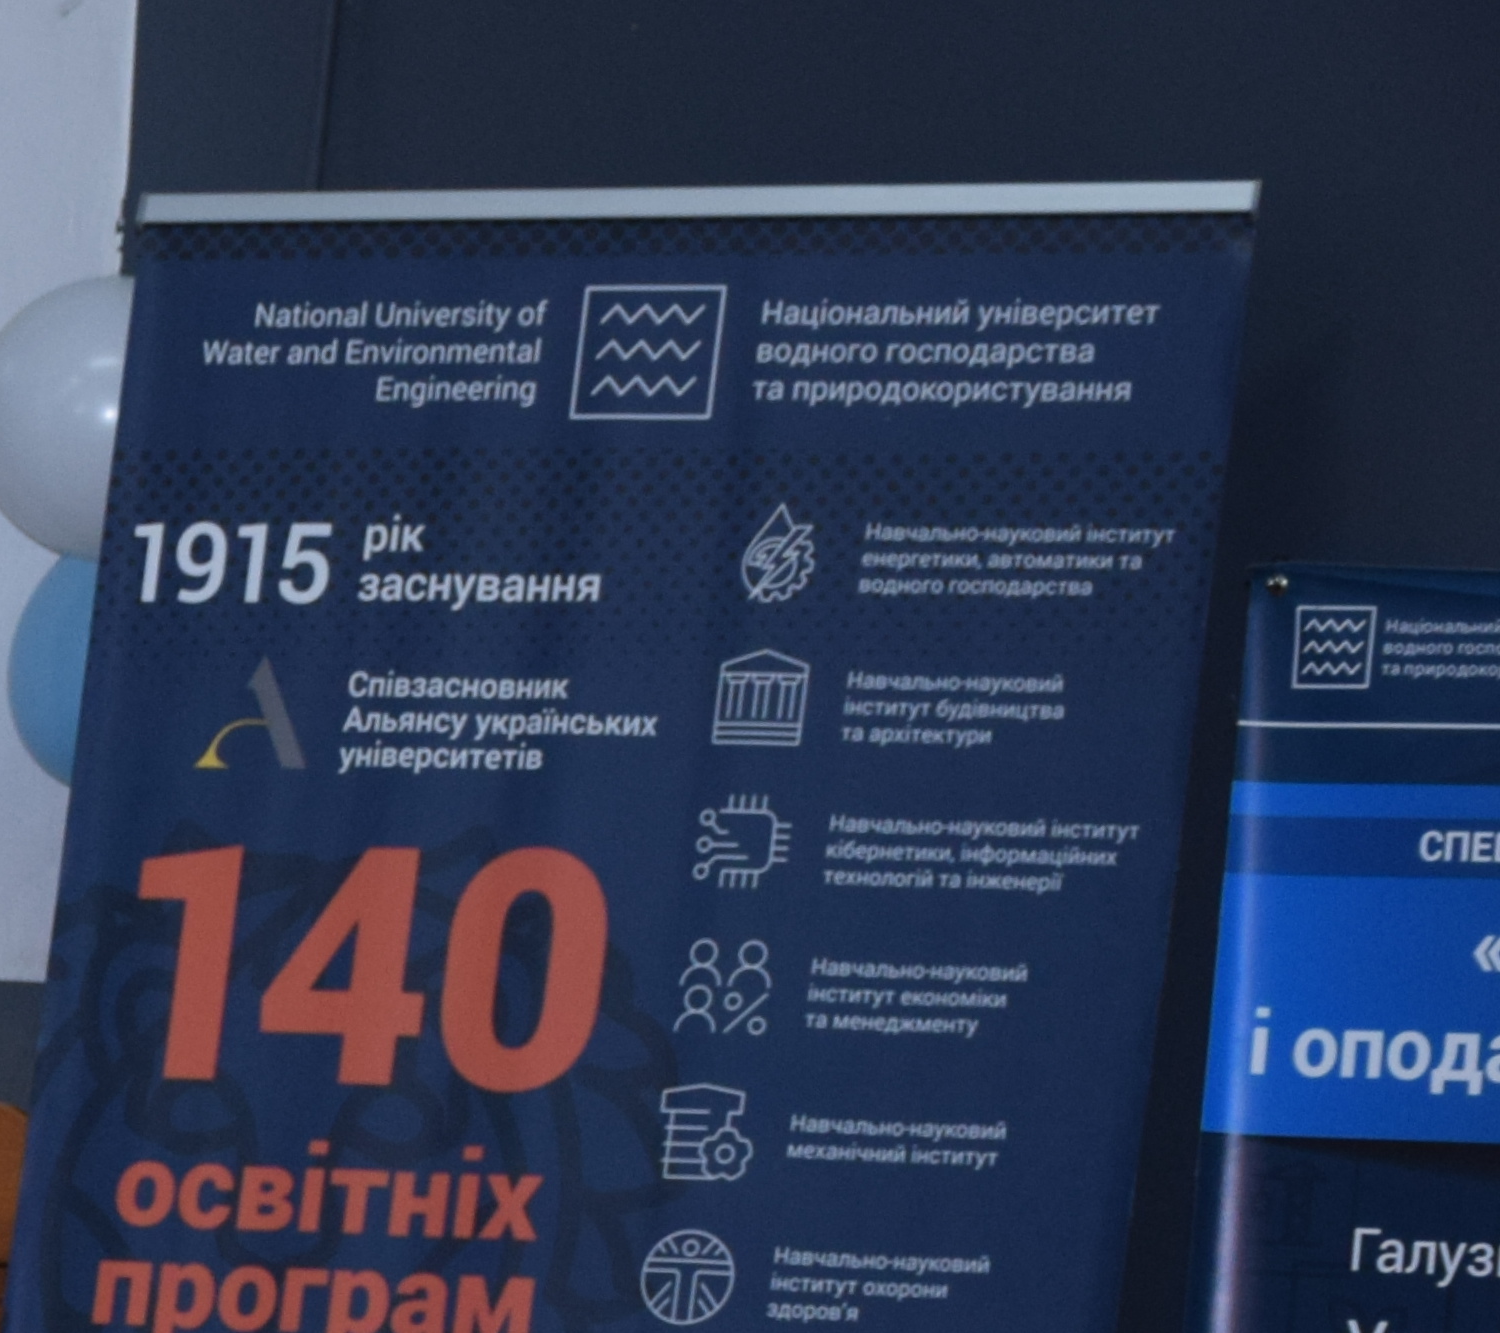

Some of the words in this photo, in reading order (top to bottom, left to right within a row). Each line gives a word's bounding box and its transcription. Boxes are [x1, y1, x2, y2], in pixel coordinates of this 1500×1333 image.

[254, 302, 367, 328] National
[376, 301, 509, 332] University
[517, 299, 549, 328] of
[761, 299, 970, 329] Національний
[977, 299, 1161, 331] університет
[203, 340, 280, 365] Water
[288, 340, 338, 364] and
[346, 339, 543, 365] Environmental
[756, 341, 879, 366] водного
[885, 342, 1096, 368] господарства
[375, 378, 537, 407] Engineering
[752, 380, 783, 401] та
[792, 380, 1133, 408] природокористування
[865, 522, 1082, 546] Навчально-науковий
[1086, 525, 1175, 547] інститут
[134, 522, 333, 604] 1915
[363, 515, 426, 561] рік
[861, 552, 982, 573] енергетики,
[987, 553, 1113, 571] автоматики
[1119, 555, 1143, 571] та
[357, 574, 601, 610] заснування
[858, 579, 943, 598] водного
[949, 579, 1093, 598] господарства
[348, 671, 569, 699] Співзасновник
[847, 671, 1064, 696] Навчально-науковий
[844, 698, 929, 720] інститут
[936, 700, 1065, 722] будівництва
[342, 707, 467, 739] Альянсу
[475, 708, 657, 741] українських
[841, 726, 864, 743] та
[868, 726, 993, 747] архітектури
[339, 743, 543, 775] університетів
[828, 815, 1046, 840] Навчально-науковий
[1051, 820, 1140, 842] інститут
[825, 842, 955, 864] кібернетики,
[960, 845, 1118, 868] інформаційних
[1419, 830, 1500, 863] СПЕ
[824, 868, 934, 890] технологій
[939, 872, 961, 889] та
[965, 872, 1064, 895] інженерії
[137, 843, 607, 1093] 140
[811, 957, 1028, 984] Навчально-науковий
[807, 984, 895, 1008] інститут
[900, 989, 1008, 1009] економіки
[805, 1010, 827, 1029] та
[833, 1011, 978, 1038] менеджменту
[1249, 1006, 1272, 1076] і
[790, 1115, 1007, 1140] Навчально-науковий
[786, 1141, 905, 1163] механічний
[911, 1144, 998, 1169] інститут
[115, 1139, 543, 1241] освітніх
[773, 1247, 990, 1274] Навчально-науковий
[1351, 1227, 1500, 1288] Галуз
[770, 1274, 856, 1297] інститут
[863, 1280, 947, 1301] охорони
